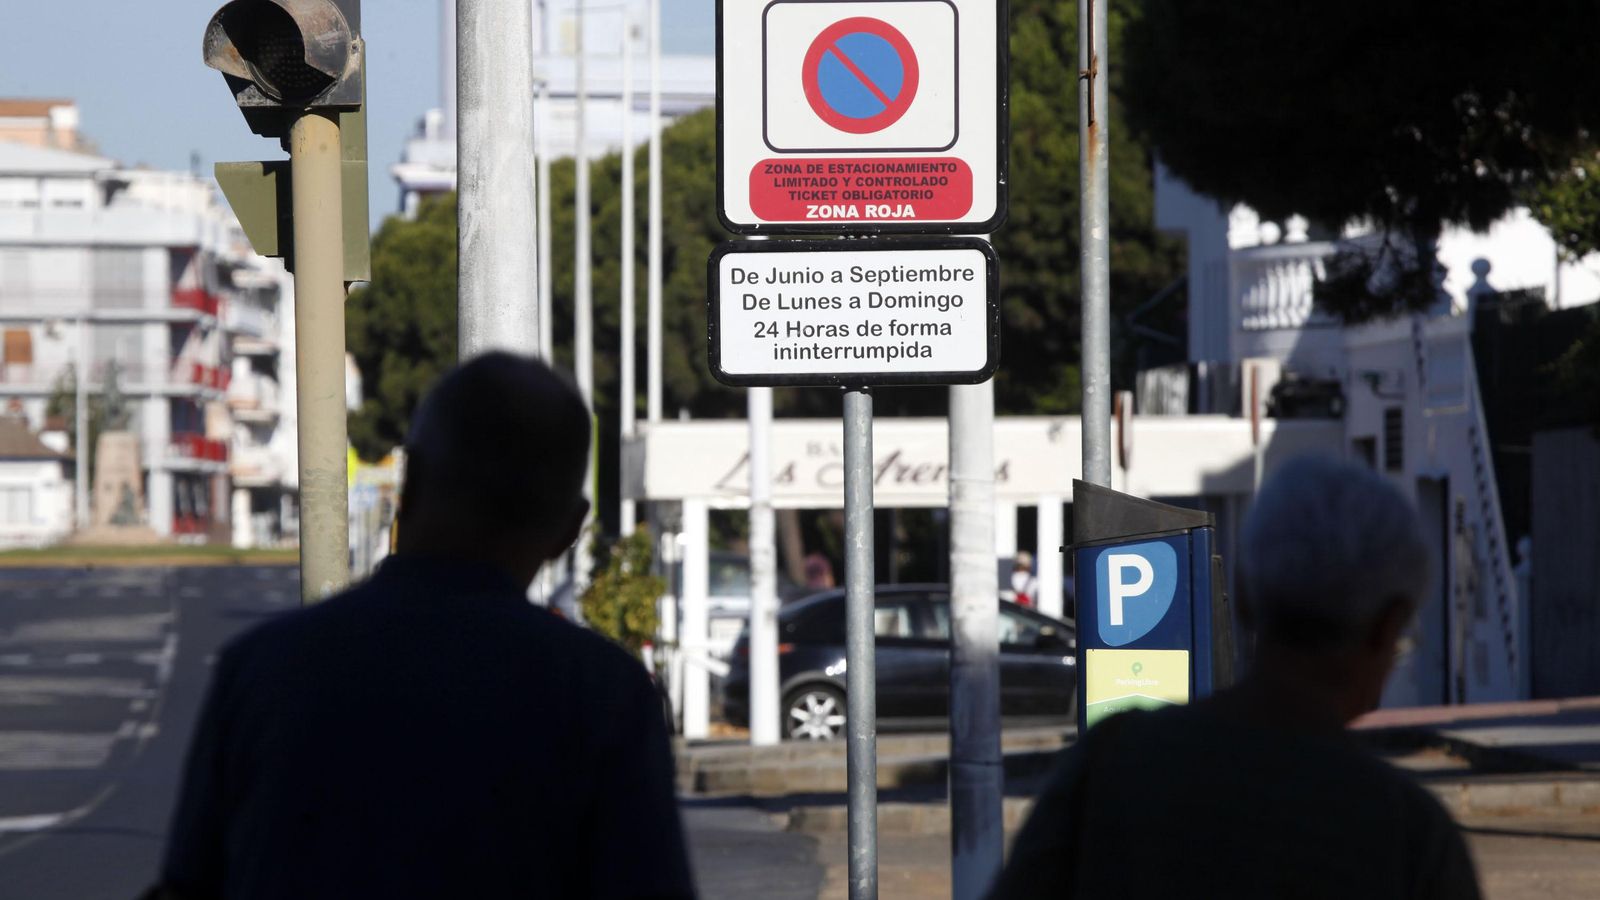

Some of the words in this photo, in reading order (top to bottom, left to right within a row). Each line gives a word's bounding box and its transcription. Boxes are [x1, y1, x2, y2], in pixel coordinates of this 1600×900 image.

[765, 163, 802, 175] ZONA
[806, 163, 824, 174] DE
[828, 162, 957, 174] ESTACIONAMIENTO
[774, 176, 838, 188] LIMITADO
[842, 176, 853, 187] Y
[856, 175, 948, 187] CONTROLADO
[788, 190, 838, 201] TICKET
[842, 189, 934, 200] OBLIGATORIO
[806, 204, 860, 219] ZONA
[865, 203, 915, 218] ROJA
[731, 267, 759, 285] De
[765, 266, 824, 284] Junio
[830, 270, 843, 283] a
[849, 265, 974, 287] Septiembre
[742, 294, 771, 311] De
[777, 293, 842, 310] Lunes
[848, 295, 861, 309] a
[868, 291, 964, 312] Domingo
[753, 321, 779, 338] 24
[786, 320, 850, 338] Horas
[856, 319, 883, 337] de
[888, 319, 952, 337] forma
[773, 341, 933, 363] ininterrumpida
[714, 450, 797, 496] Ls
[815, 447, 1009, 490] Arens
[1108, 553, 1154, 625] P
